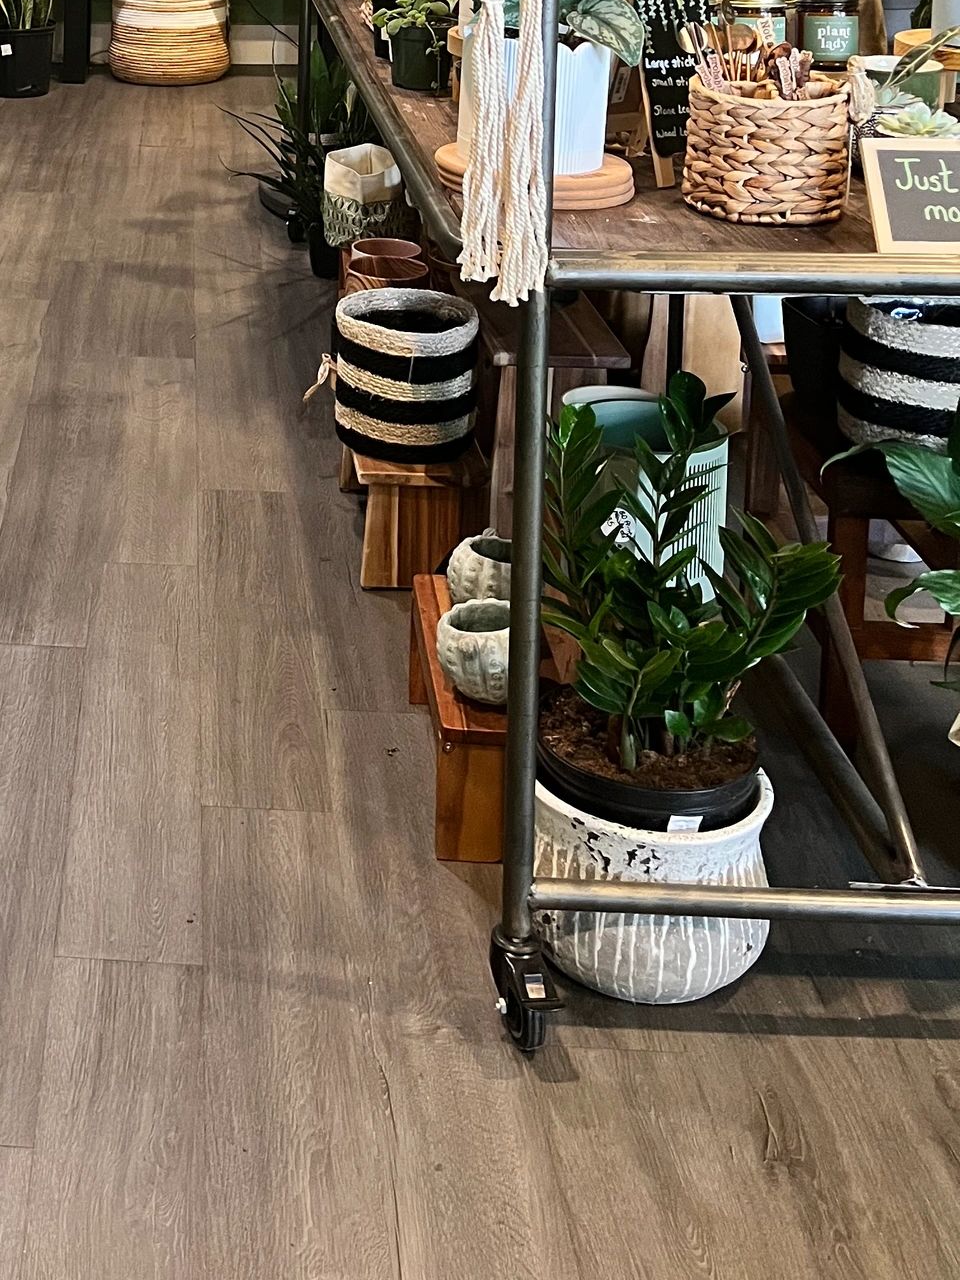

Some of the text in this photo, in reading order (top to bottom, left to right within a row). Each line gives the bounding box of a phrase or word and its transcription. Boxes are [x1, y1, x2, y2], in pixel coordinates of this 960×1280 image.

[817, 25, 851, 40] plant
[820, 38, 849, 52] lady
[893, 157, 959, 194] Just
